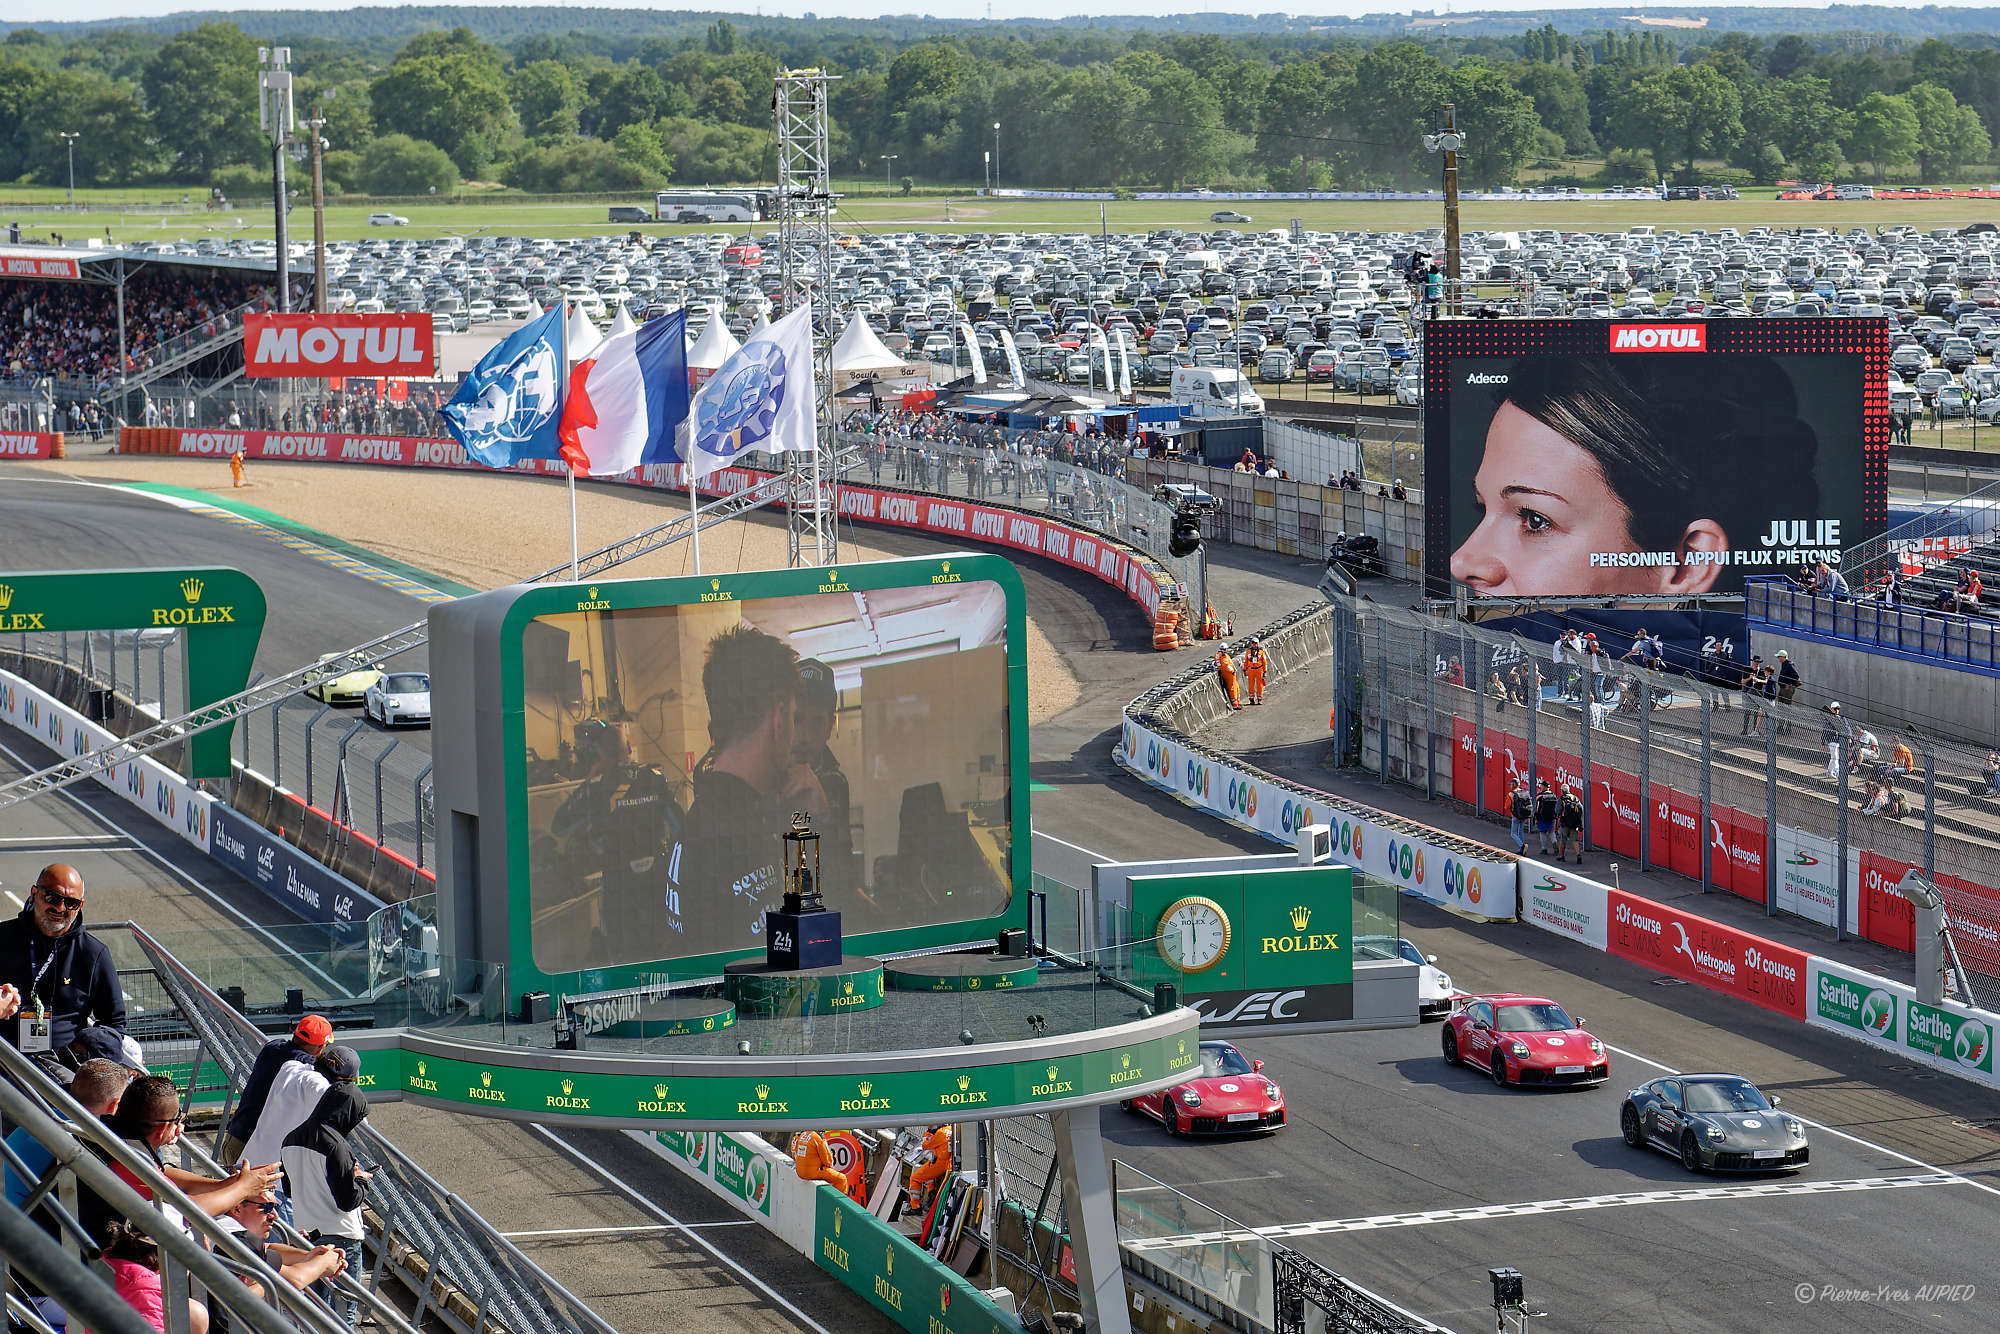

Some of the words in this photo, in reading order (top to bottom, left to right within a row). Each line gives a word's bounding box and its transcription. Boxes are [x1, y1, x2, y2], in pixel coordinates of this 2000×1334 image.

[41, 261, 70, 275] MOTUL
[254, 327, 424, 364] MOTUL
[1615, 329, 1702, 348] MOTUL
[1467, 373, 1508, 385] Adecco
[0, 435, 38, 454] TUL
[179, 432, 247, 452] MOTUL
[262, 435, 328, 457] MOTUL
[341, 438, 403, 461] MOTUL
[414, 442, 472, 464] MOTU
[718, 471, 749, 493] MOTUL
[839, 490, 875, 518] MOTUL
[880, 496, 919, 524] MOTUL
[928, 503, 966, 531] MOTUL
[1009, 518, 1040, 548] MOTUL
[1761, 519, 1841, 546] JULIE
[1590, 552, 1680, 567] PERSONNEL
[1683, 551, 1730, 566] APPUI
[1734, 550, 1772, 565] FLUX
[1776, 547, 1841, 565] PIÉTONS
[818, 583, 850, 593] ROLEX
[932, 573, 964, 584] ROLEX
[577, 600, 611, 611] ROLEX
[701, 591, 733, 602] ROLEX
[0, 613, 45, 630] LEX
[152, 606, 235, 625] ROLEX
[1619, 804, 1640, 824] Métrop
[1672, 811, 1695, 829] course
[297, 881, 304, 901] LE
[304, 885, 320, 909] MANS
[1181, 918, 1206, 926] ROLEX
[1632, 913, 1662, 935] course
[1261, 933, 1340, 954] ROLEX
[1696, 949, 1735, 976] Métropole
[1763, 958, 1796, 982] course
[970, 978, 978, 987] 3
[1764, 975, 1796, 1006] MANS
[831, 995, 865, 1007] ROLEX
[1820, 976, 1860, 1011] Sarthe
[1188, 990, 1306, 1023] WEC
[706, 1019, 712, 1029] 2
[1910, 1006, 1952, 1041] Sarthe
[1170, 1053, 1193, 1070] ROLEX
[410, 1075, 437, 1092] ROLEX
[1110, 1068, 1143, 1084] ROLEX
[469, 1087, 506, 1102] ROLEX
[1032, 1080, 1073, 1096] ROLEX
[546, 1096, 590, 1109] ROLEX
[638, 1101, 686, 1113] ROLEX
[738, 1102, 788, 1113] ROLEX
[840, 1098, 891, 1111] ROLEX
[940, 1091, 987, 1105] ROLEX
[717, 1136, 744, 1177] Sarthe
[824, 1236, 849, 1272] ROLEX
[875, 1274, 902, 1312] ROLEX
